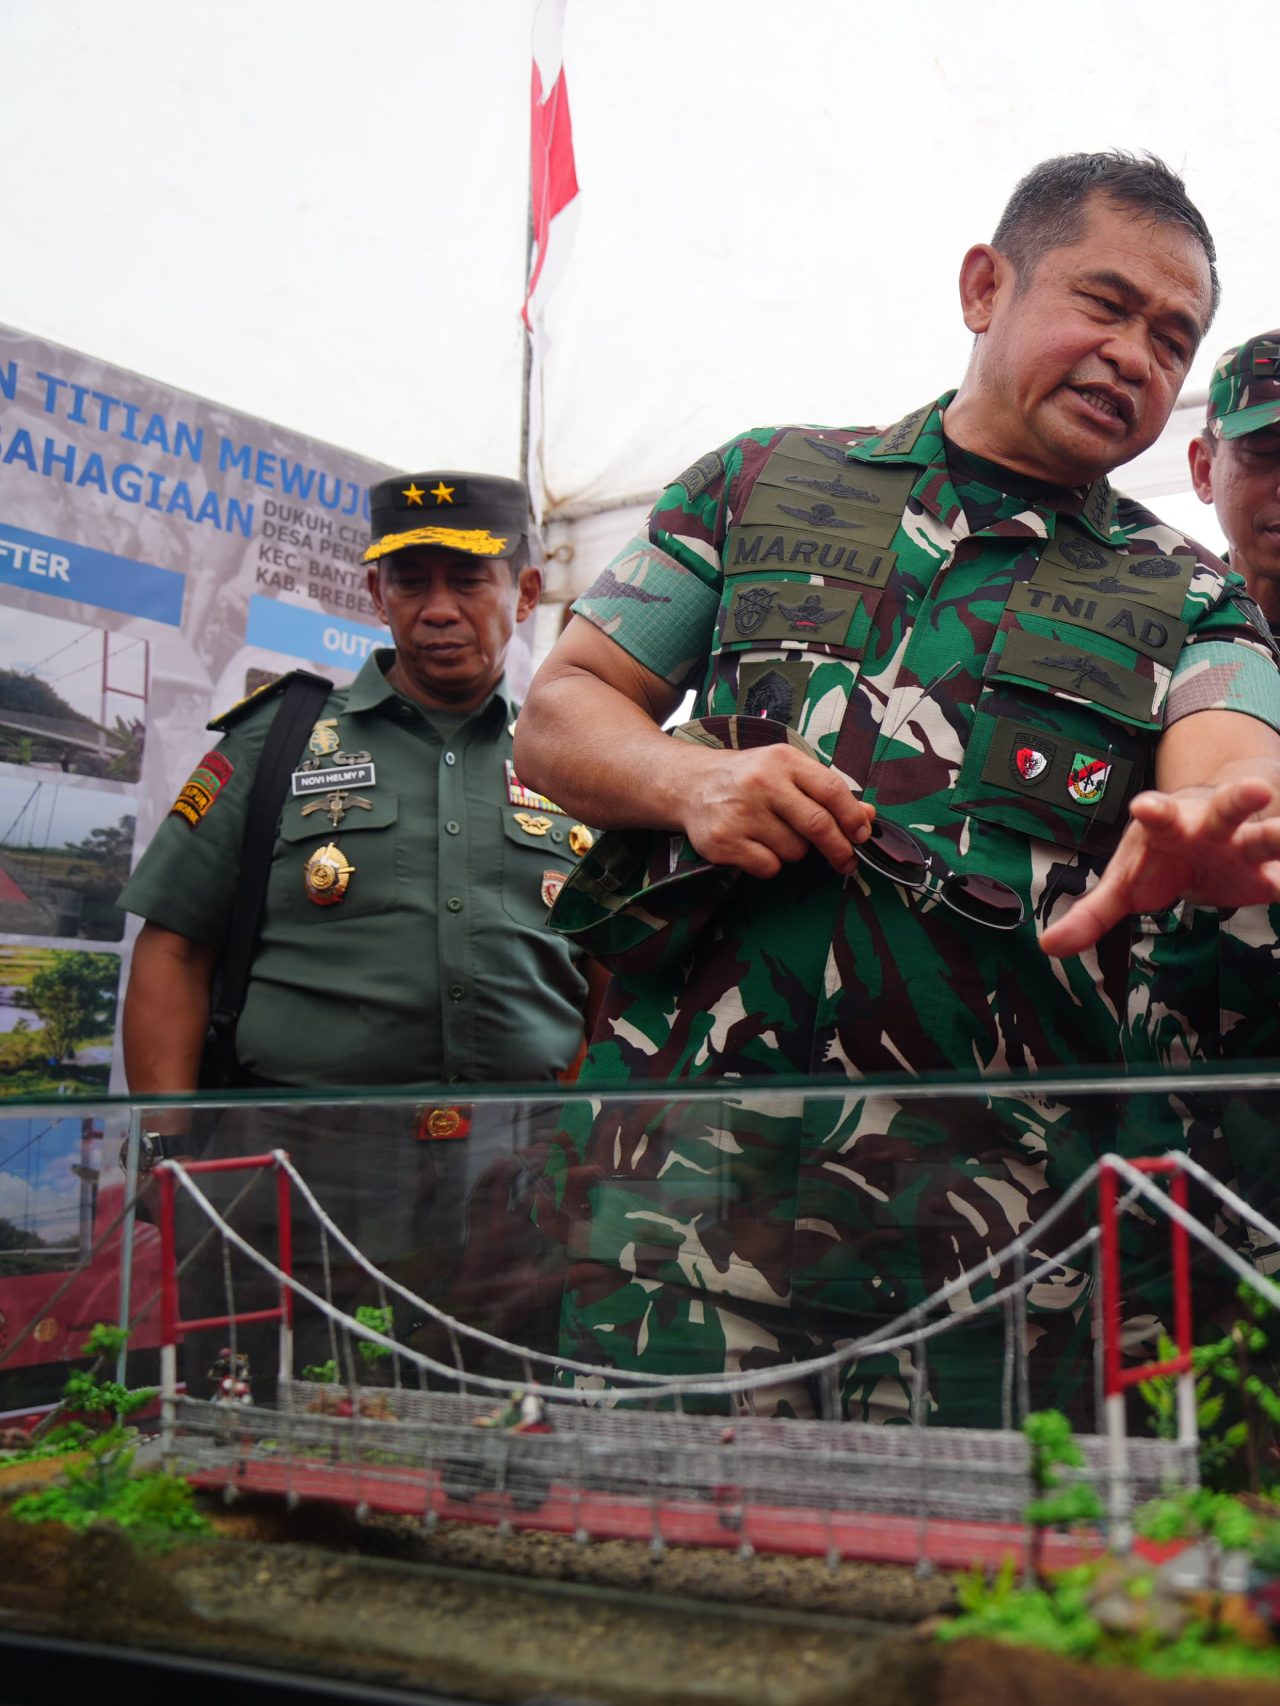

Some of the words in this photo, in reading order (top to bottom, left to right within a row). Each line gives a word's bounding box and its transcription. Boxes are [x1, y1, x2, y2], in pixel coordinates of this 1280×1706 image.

[36, 371, 204, 464] TITIAN
[0, 428, 254, 539] AHAGIAAN
[262, 521, 313, 550] DESA
[264, 499, 332, 537] DUKUH
[259, 543, 302, 572] KEC.
[733, 535, 882, 578] MARULI
[256, 566, 300, 594] KAB.
[1027, 588, 1098, 620] TNI
[1107, 608, 1169, 649] AD
[301, 777, 325, 786] NOVI
[326, 771, 357, 782] HELMY
[359, 770, 366, 778] P
